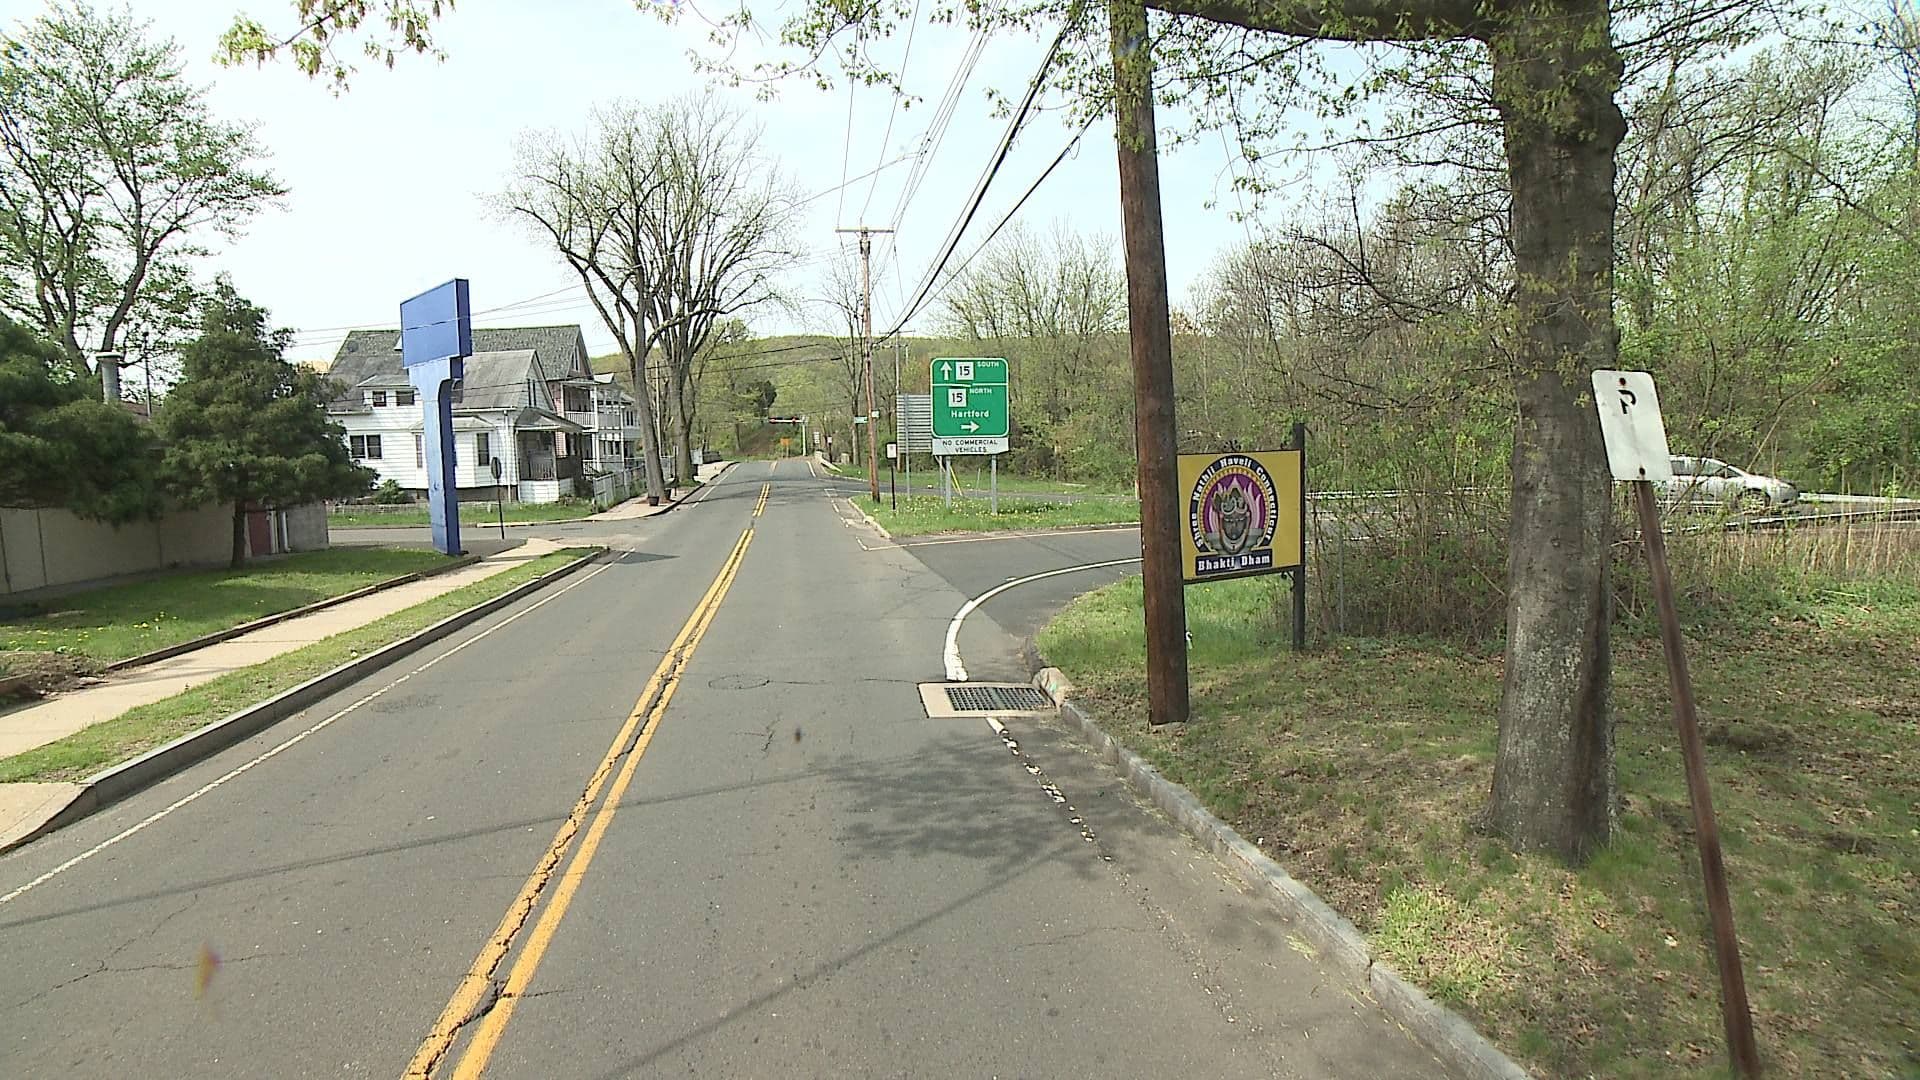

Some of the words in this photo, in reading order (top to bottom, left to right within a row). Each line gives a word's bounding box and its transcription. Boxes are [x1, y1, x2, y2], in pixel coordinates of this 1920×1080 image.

[959, 366, 970, 376] 15
[952, 392, 963, 403] 15
[951, 410, 990, 418] Hartford
[1219, 457, 1253, 468] Haveli
[1256, 467, 1277, 541] Connecticut
[1198, 557, 1236, 571] Bhakti
[1241, 555, 1270, 567] Dham
